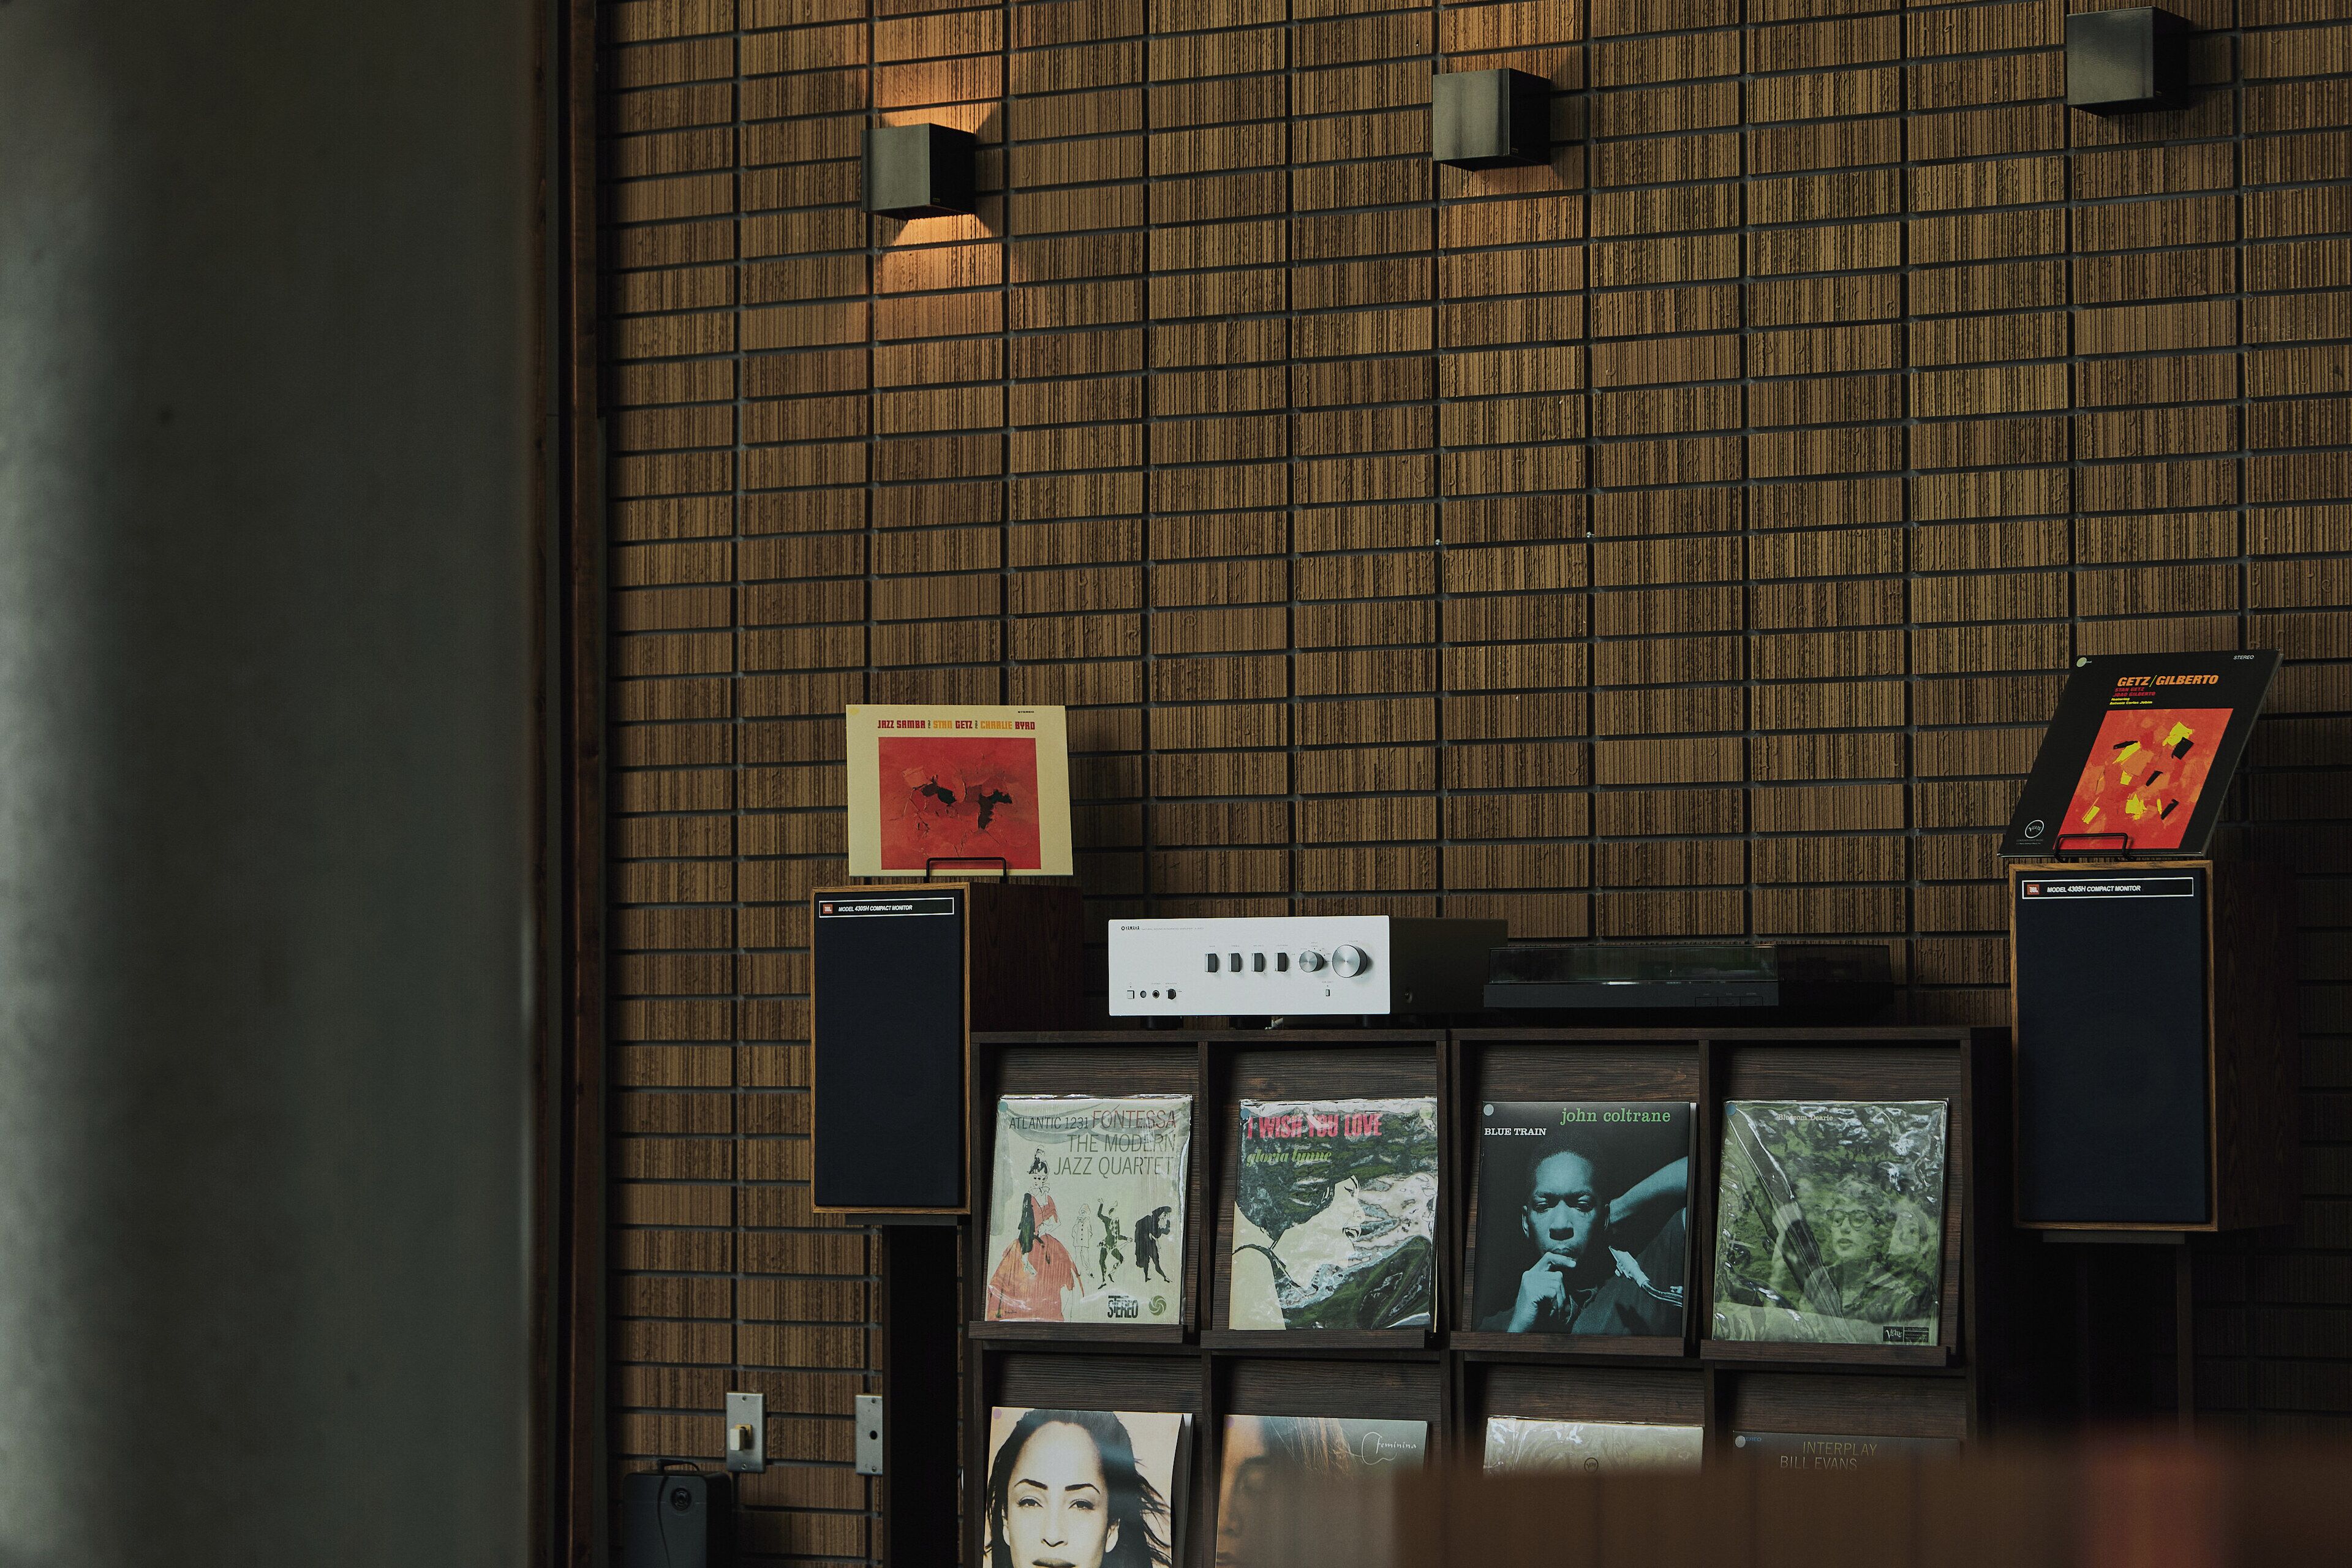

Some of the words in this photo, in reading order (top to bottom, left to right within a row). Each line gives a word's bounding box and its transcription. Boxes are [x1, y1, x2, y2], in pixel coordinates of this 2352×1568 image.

[2117, 674, 2219, 687] GETZ/GILBERTO
[877, 720, 894, 729] JAZZ
[896, 720, 925, 729] SAMBA
[933, 720, 952, 729] STAN
[955, 720, 973, 729] GETZ
[980, 721, 1012, 729] CHARLIE
[1015, 721, 1035, 730] BYRD
[1009, 1117, 1061, 1129] ATLANTIC
[1065, 1117, 1089, 1129] 1231
[1093, 1110, 1177, 1129] FONTESSA
[1247, 1116, 1254, 1140] I
[1259, 1115, 1302, 1139] WISH
[1306, 1114, 1339, 1137] YOU
[1344, 1112, 1383, 1137] LOVE
[1560, 1107, 1597, 1126] john
[1603, 1107, 1671, 1123] coltrane
[1513, 1128, 1547, 1136] TRAIN
[1067, 1134, 1099, 1153] THE
[1104, 1133, 1176, 1153] MODERN
[1246, 1148, 1289, 1167] gloria
[1291, 1148, 1332, 1166] lynne
[1054, 1156, 1093, 1175] JAZZ
[1098, 1156, 1174, 1179] QUARTET
[1107, 1295, 1139, 1319] STEREO
[1803, 1441, 1878, 1457] INTERPLAY
[1780, 1455, 1809, 1469] BILL
[1814, 1457, 1858, 1471] EVANS
